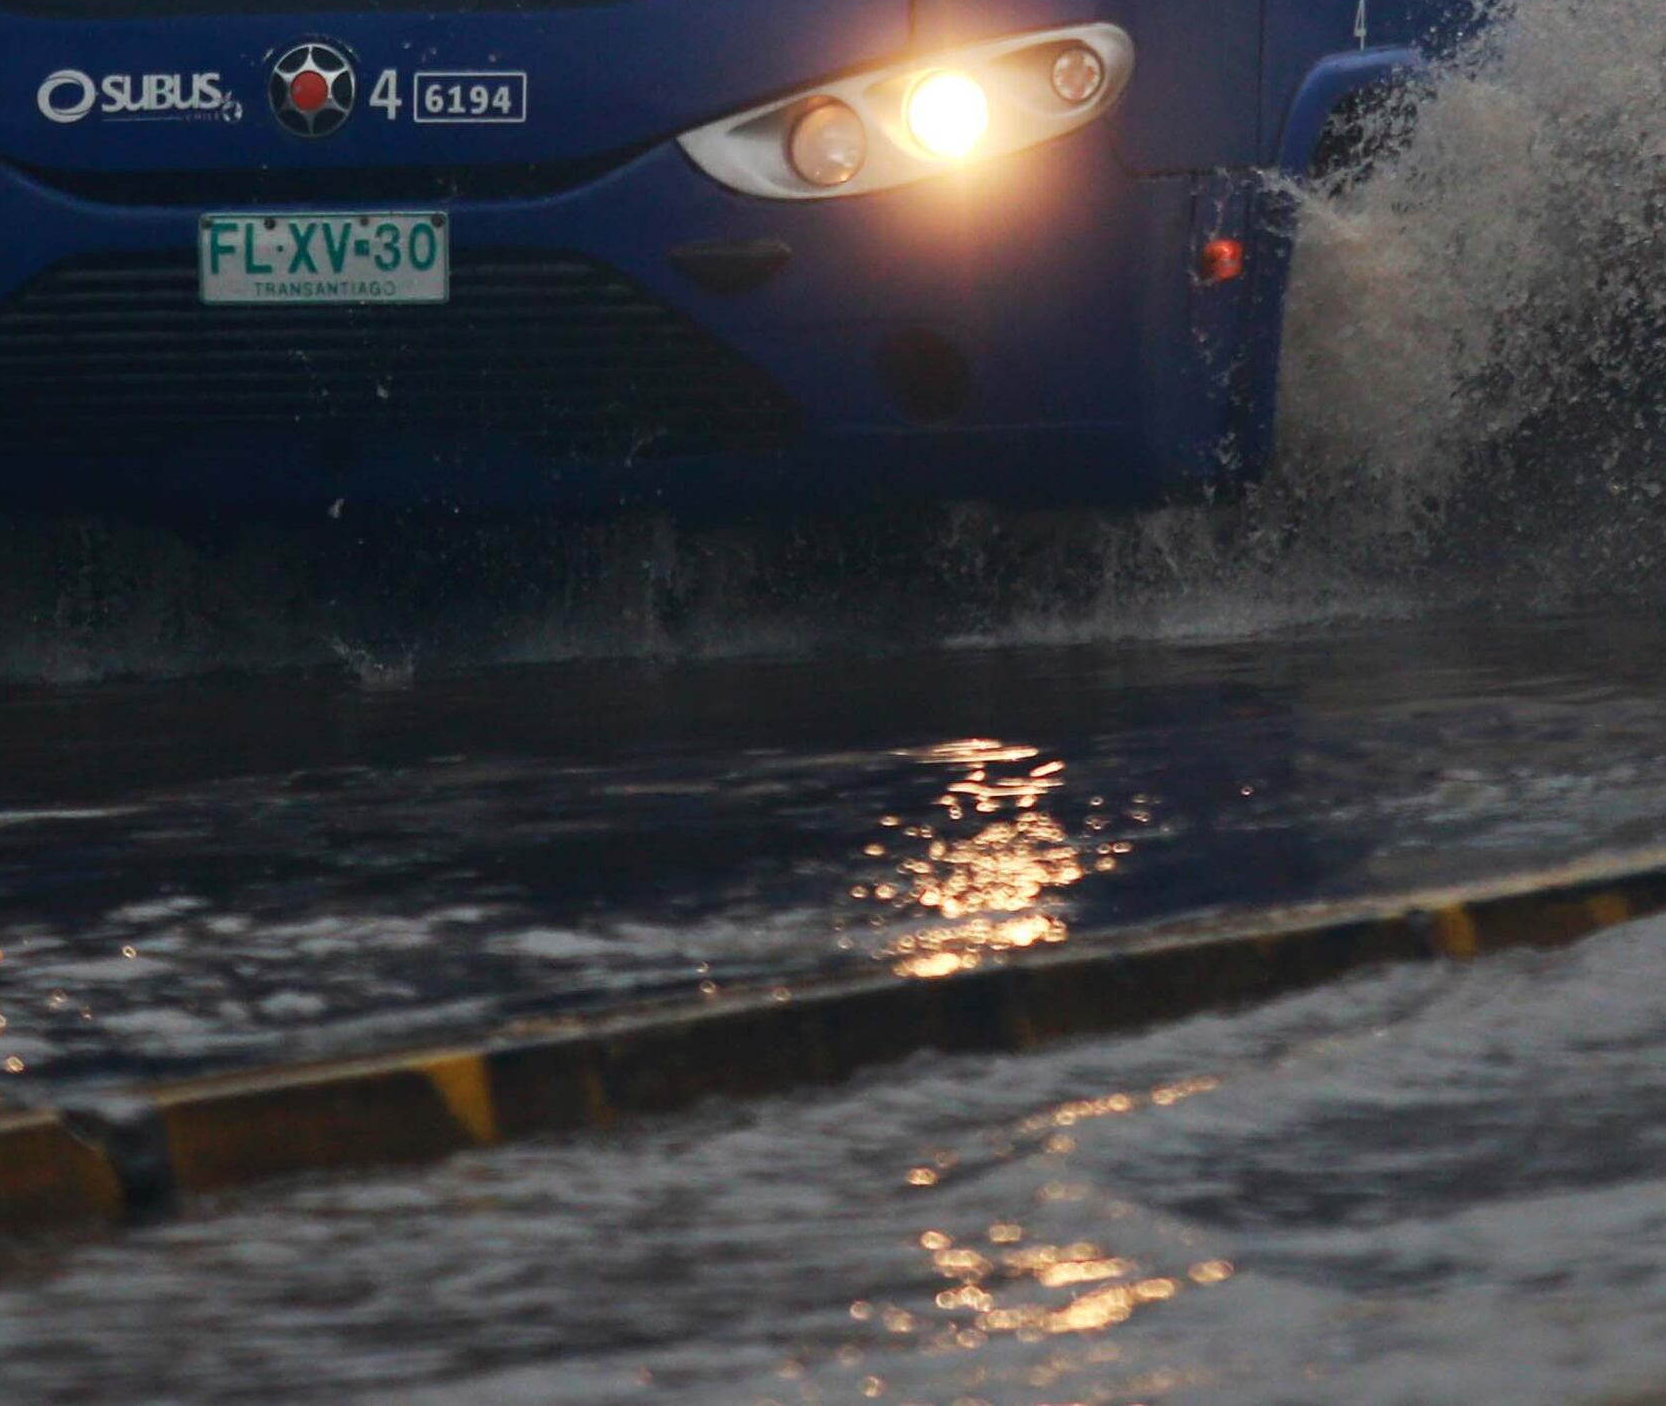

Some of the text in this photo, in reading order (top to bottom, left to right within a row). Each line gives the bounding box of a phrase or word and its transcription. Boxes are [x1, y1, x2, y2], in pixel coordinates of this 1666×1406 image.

[369, 68, 402, 121] 4
[424, 84, 513, 115] 6194
[254, 281, 397, 297] TRANSANTIAGO
